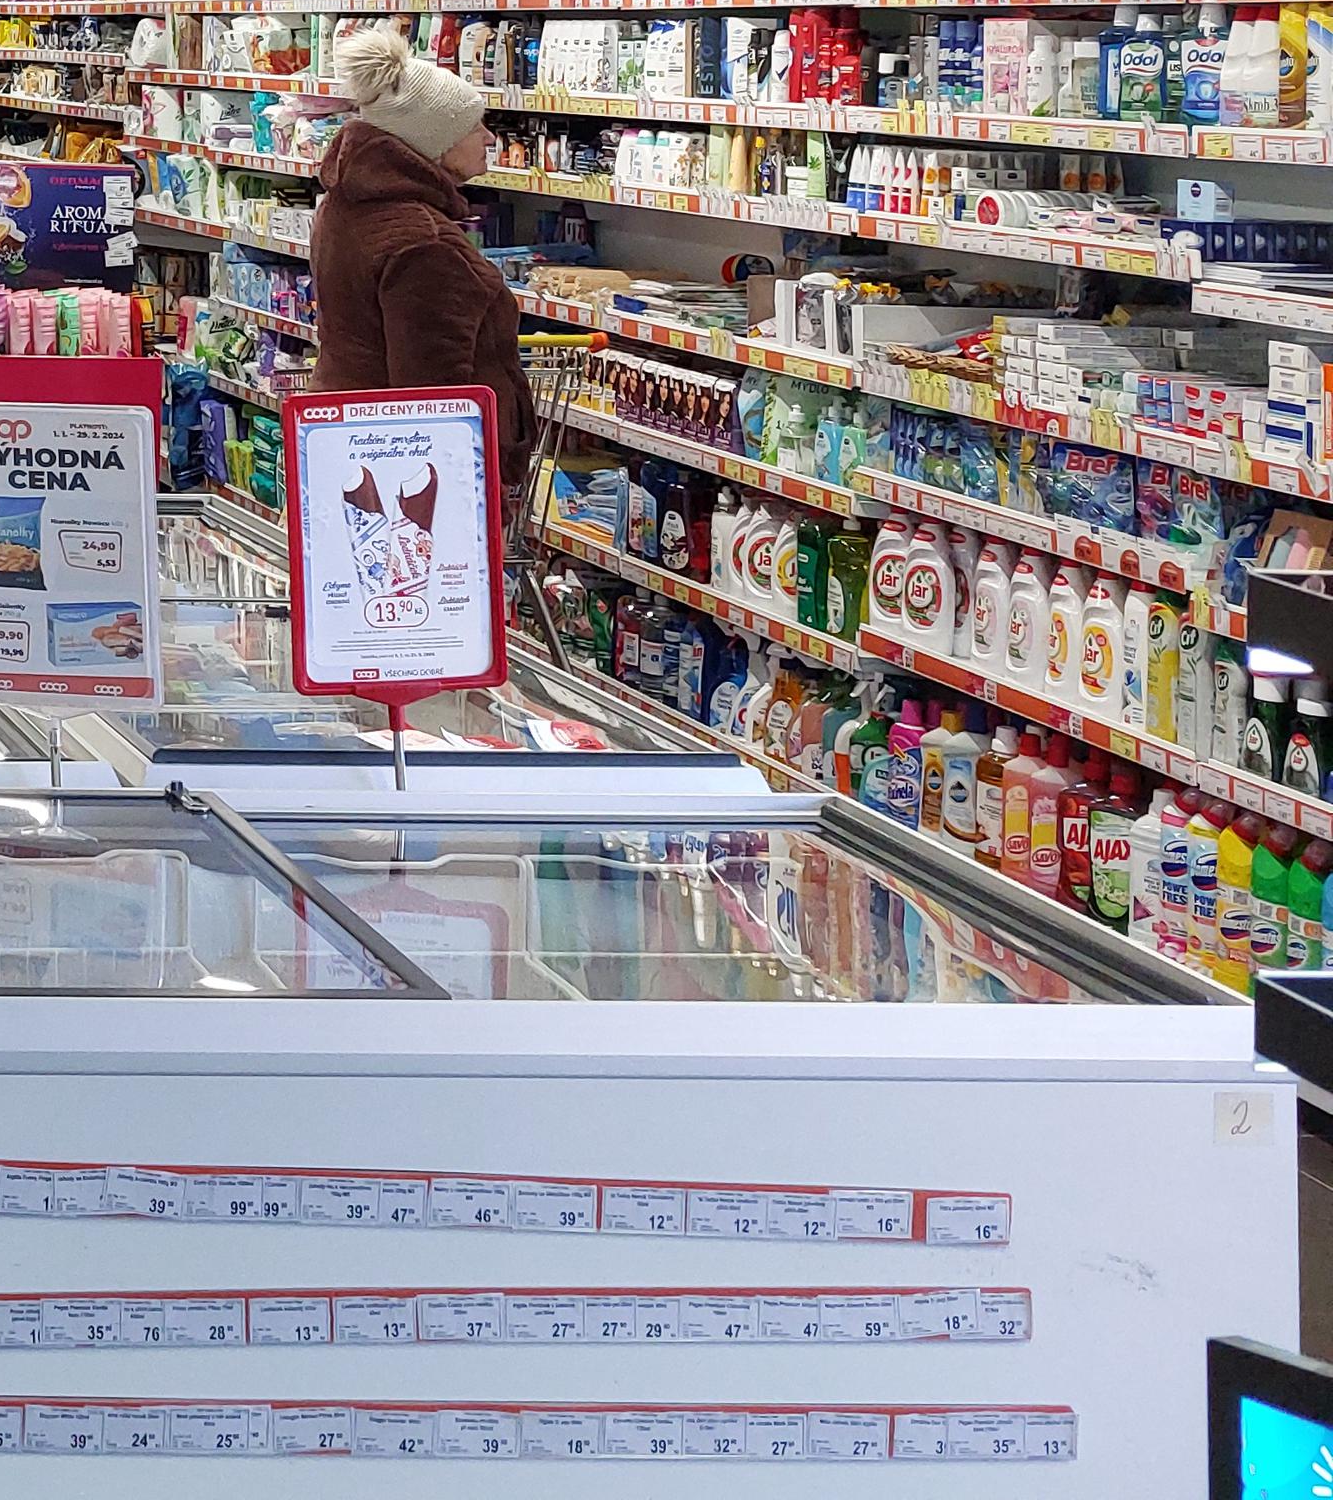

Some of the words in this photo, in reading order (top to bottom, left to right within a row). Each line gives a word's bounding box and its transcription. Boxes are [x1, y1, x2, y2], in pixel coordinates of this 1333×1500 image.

[1123, 51, 1158, 67] Odol
[52, 204, 105, 220] AROM
[303, 407, 340, 421] coop
[382, 404, 415, 417] CENY
[440, 402, 472, 414] ZEMI
[1065, 450, 1117, 473] Bref
[8, 470, 92, 492] CENA
[1180, 473, 1210, 500] Bref
[82, 541, 116, 553] 24,90
[880, 573, 900, 589] Jar
[911, 581, 929, 598] Jar
[1162, 880, 1188, 894] POWE
[1162, 893, 1188, 906] FRES
